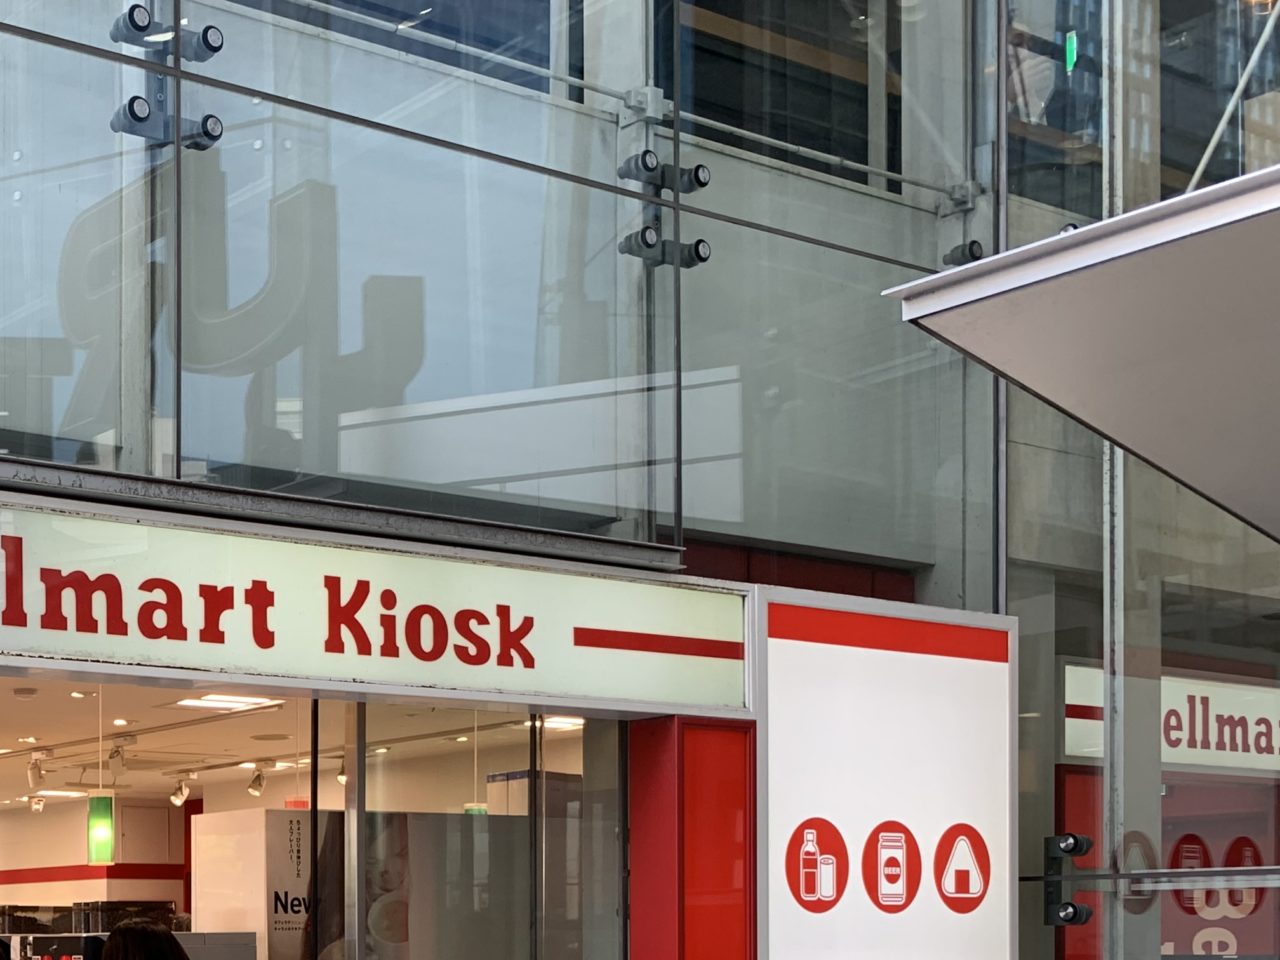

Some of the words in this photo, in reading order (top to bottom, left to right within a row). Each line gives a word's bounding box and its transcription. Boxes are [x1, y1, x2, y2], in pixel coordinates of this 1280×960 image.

[324, 575, 536, 670] Kiosk
[1163, 694, 1280, 756] ellma
[884, 867, 901, 875] BEER
